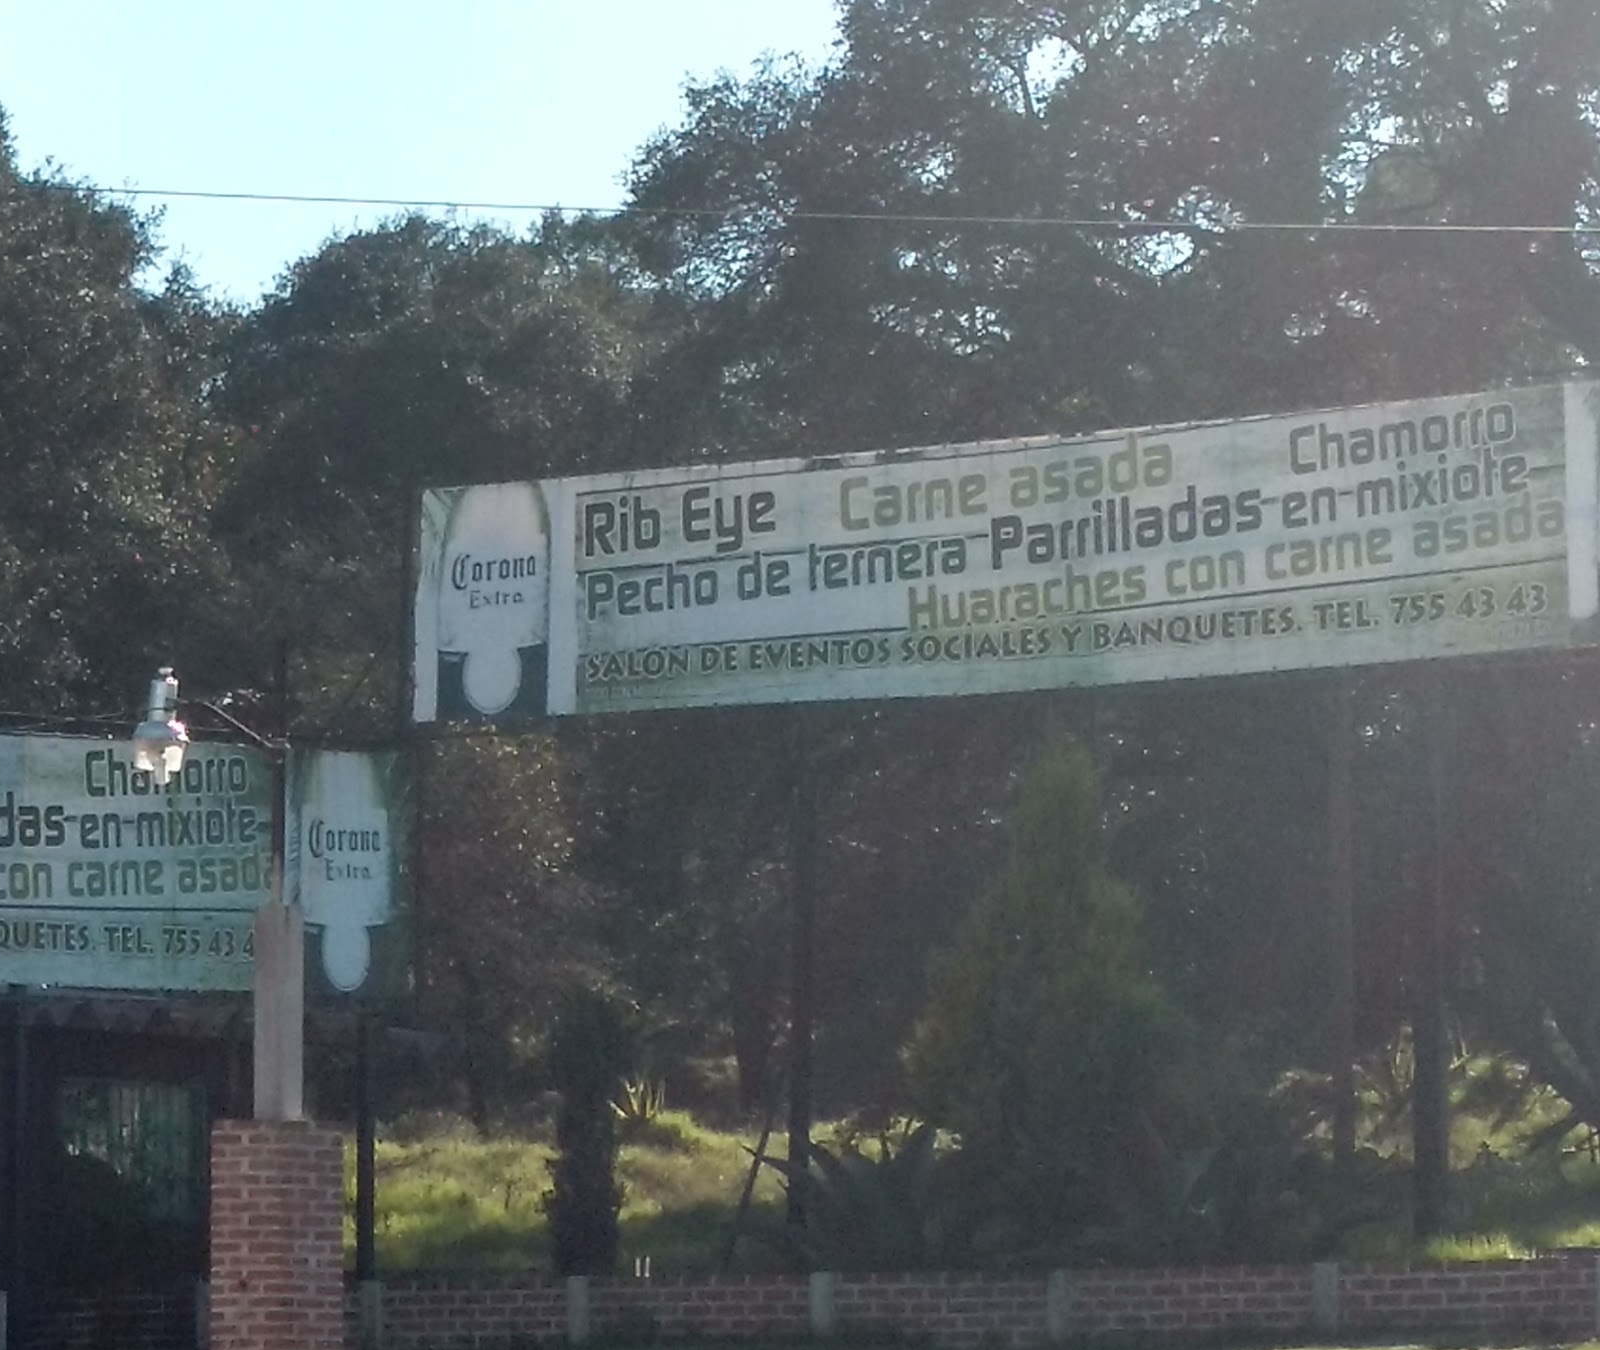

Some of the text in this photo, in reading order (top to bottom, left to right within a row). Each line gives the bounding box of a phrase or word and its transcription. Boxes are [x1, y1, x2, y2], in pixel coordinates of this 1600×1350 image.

[585, 401, 1516, 558] Rib Eye Carne asada Chamorro
[586, 447, 1530, 622] Pecho de ternera Parrilladas en mixiote
[451, 553, 536, 590] Corona
[907, 494, 1565, 632] Huaraches con carne asada
[701, 644, 739, 674] DE
[751, 636, 891, 671] EVENTOS
[900, 620, 1051, 661] SOCIALES
[1061, 624, 1083, 654] Y
[1312, 598, 1379, 631] TEL.
[1390, 593, 1446, 626] 755
[1455, 587, 1497, 620] 43
[1505, 582, 1548, 617] 43
[79, 813, 122, 849] en
[136, 798, 257, 848] mixiote
[309, 820, 381, 857] Corona
[66, 858, 165, 898] carne
[103, 925, 154, 954] TEL.
[162, 925, 201, 955] 755
[208, 928, 235, 957] 43
